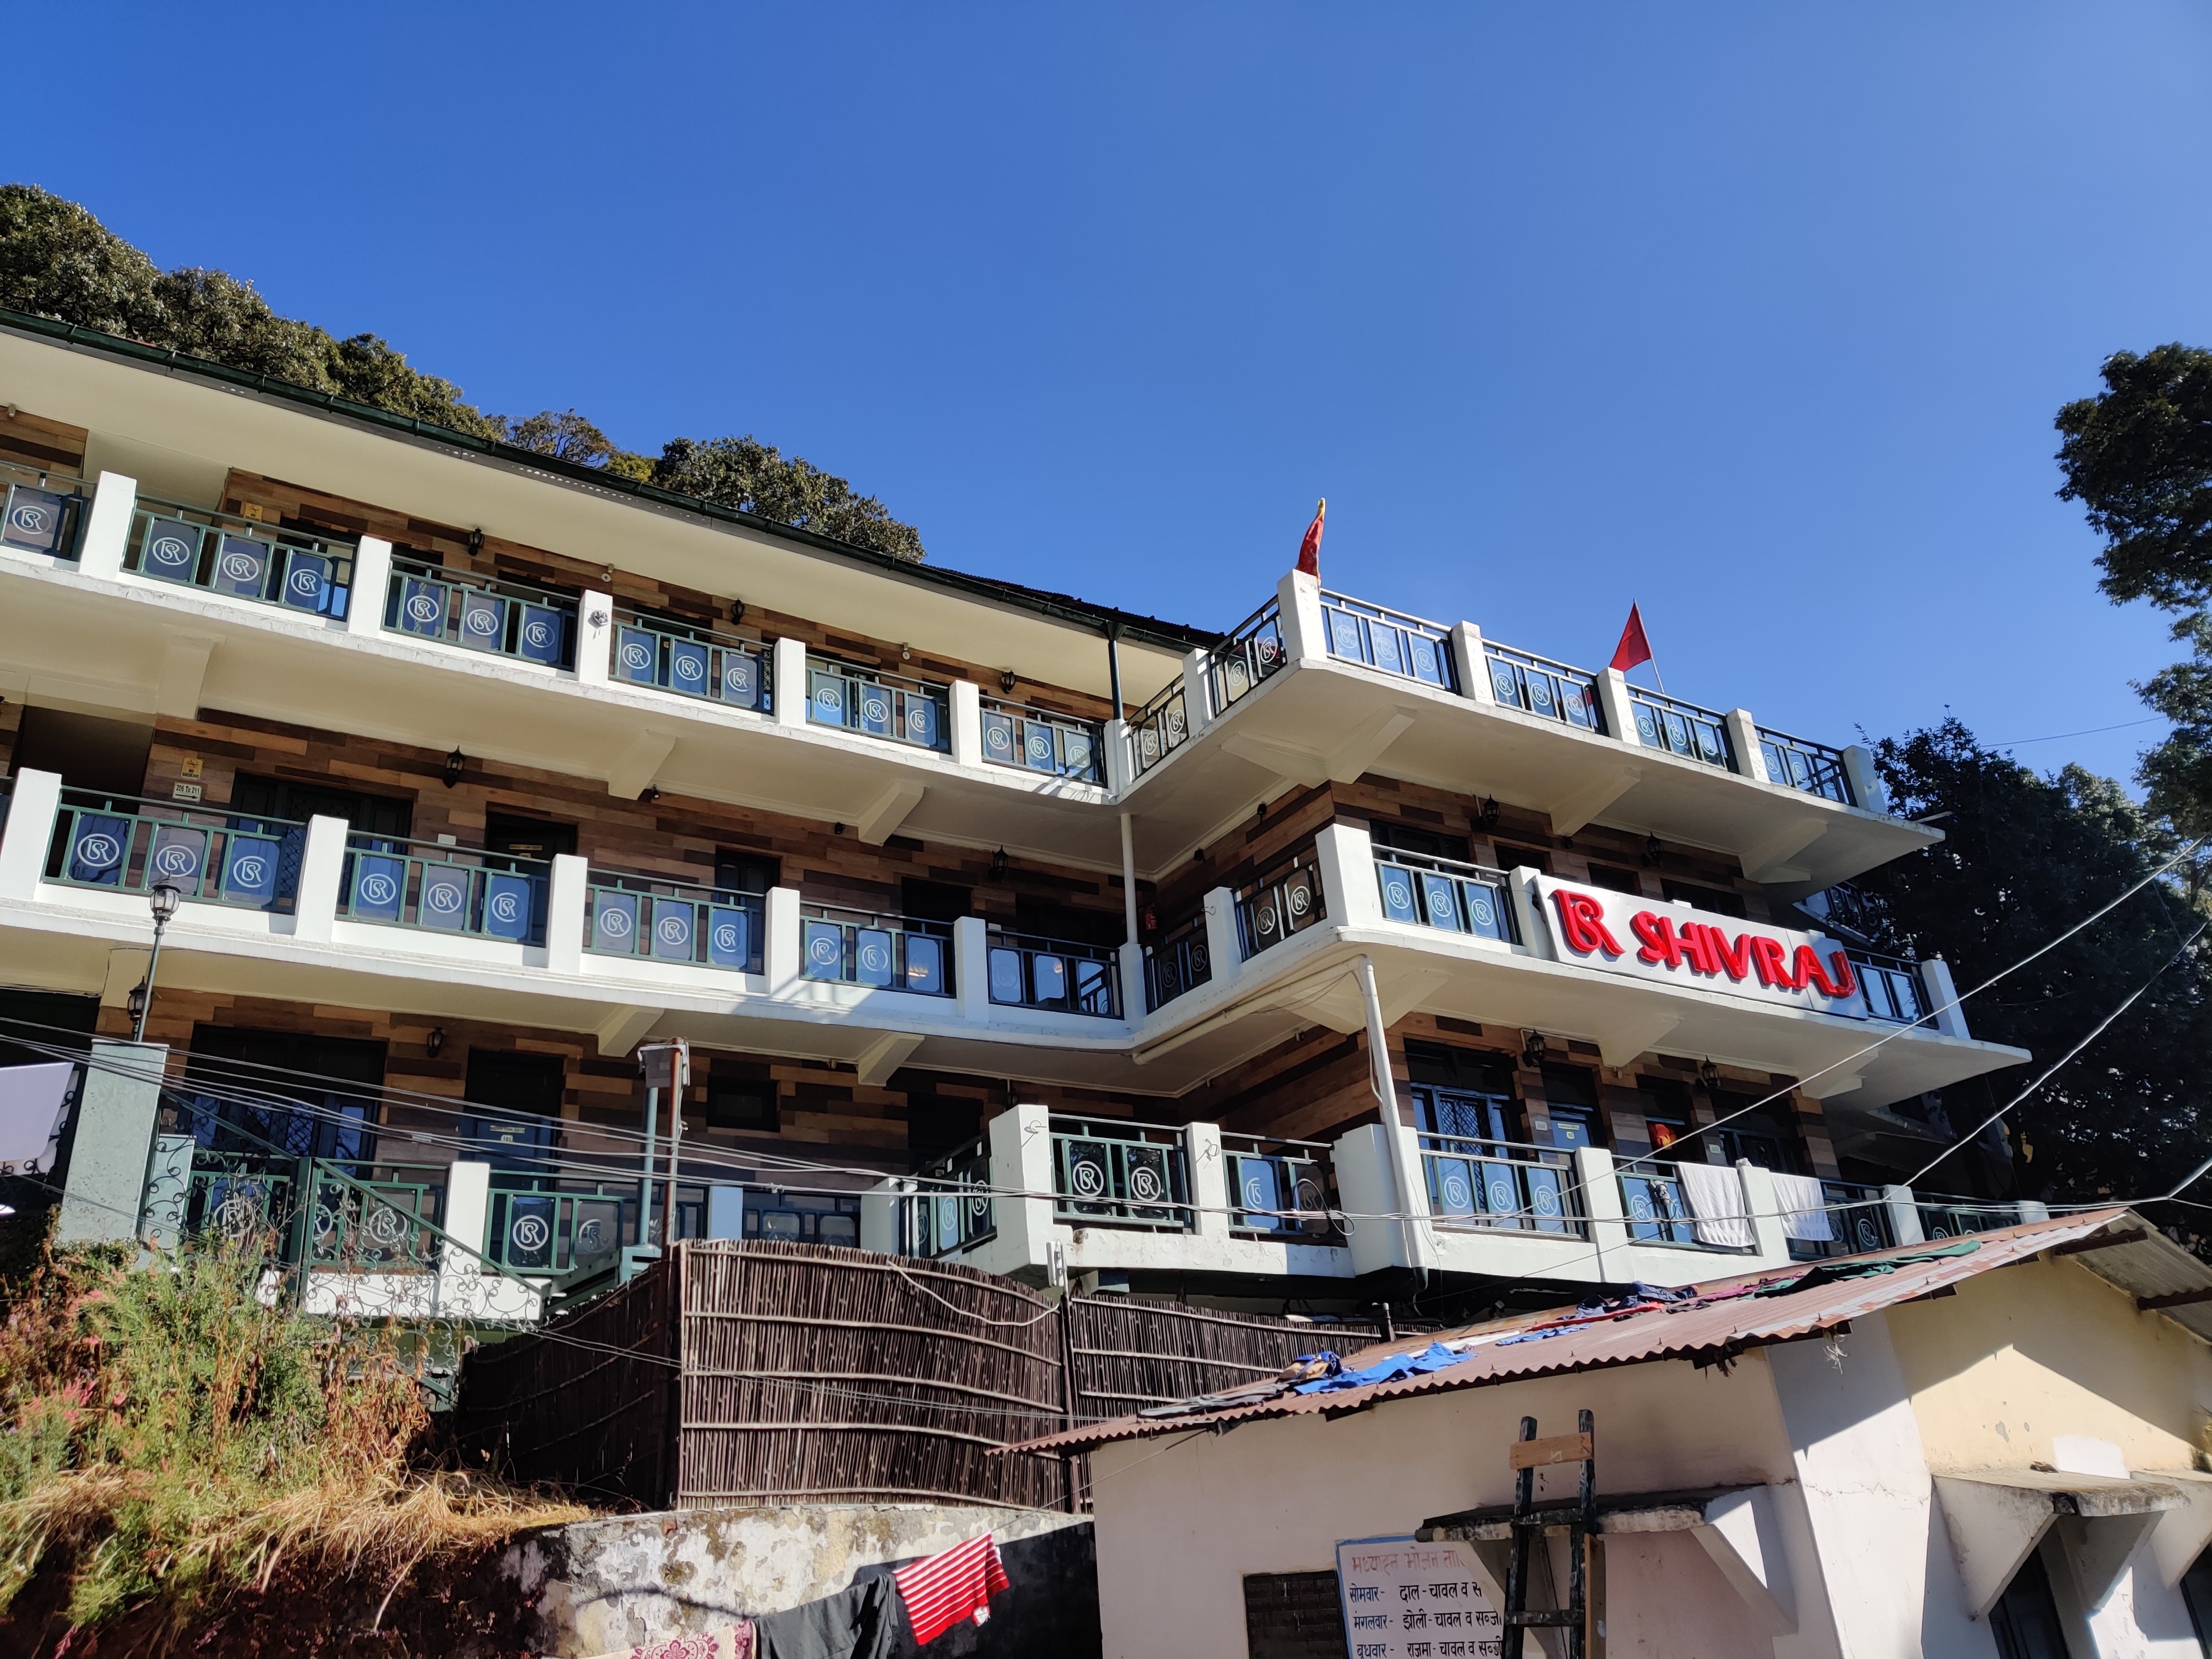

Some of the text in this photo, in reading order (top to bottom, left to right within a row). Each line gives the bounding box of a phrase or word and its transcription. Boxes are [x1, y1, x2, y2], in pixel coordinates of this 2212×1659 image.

[1631, 910, 1856, 998] SHIVRAJ
[1461, 1582, 1469, 1598] व
[1465, 1611, 1473, 1627] व
[1468, 1641, 1475, 1656] व
